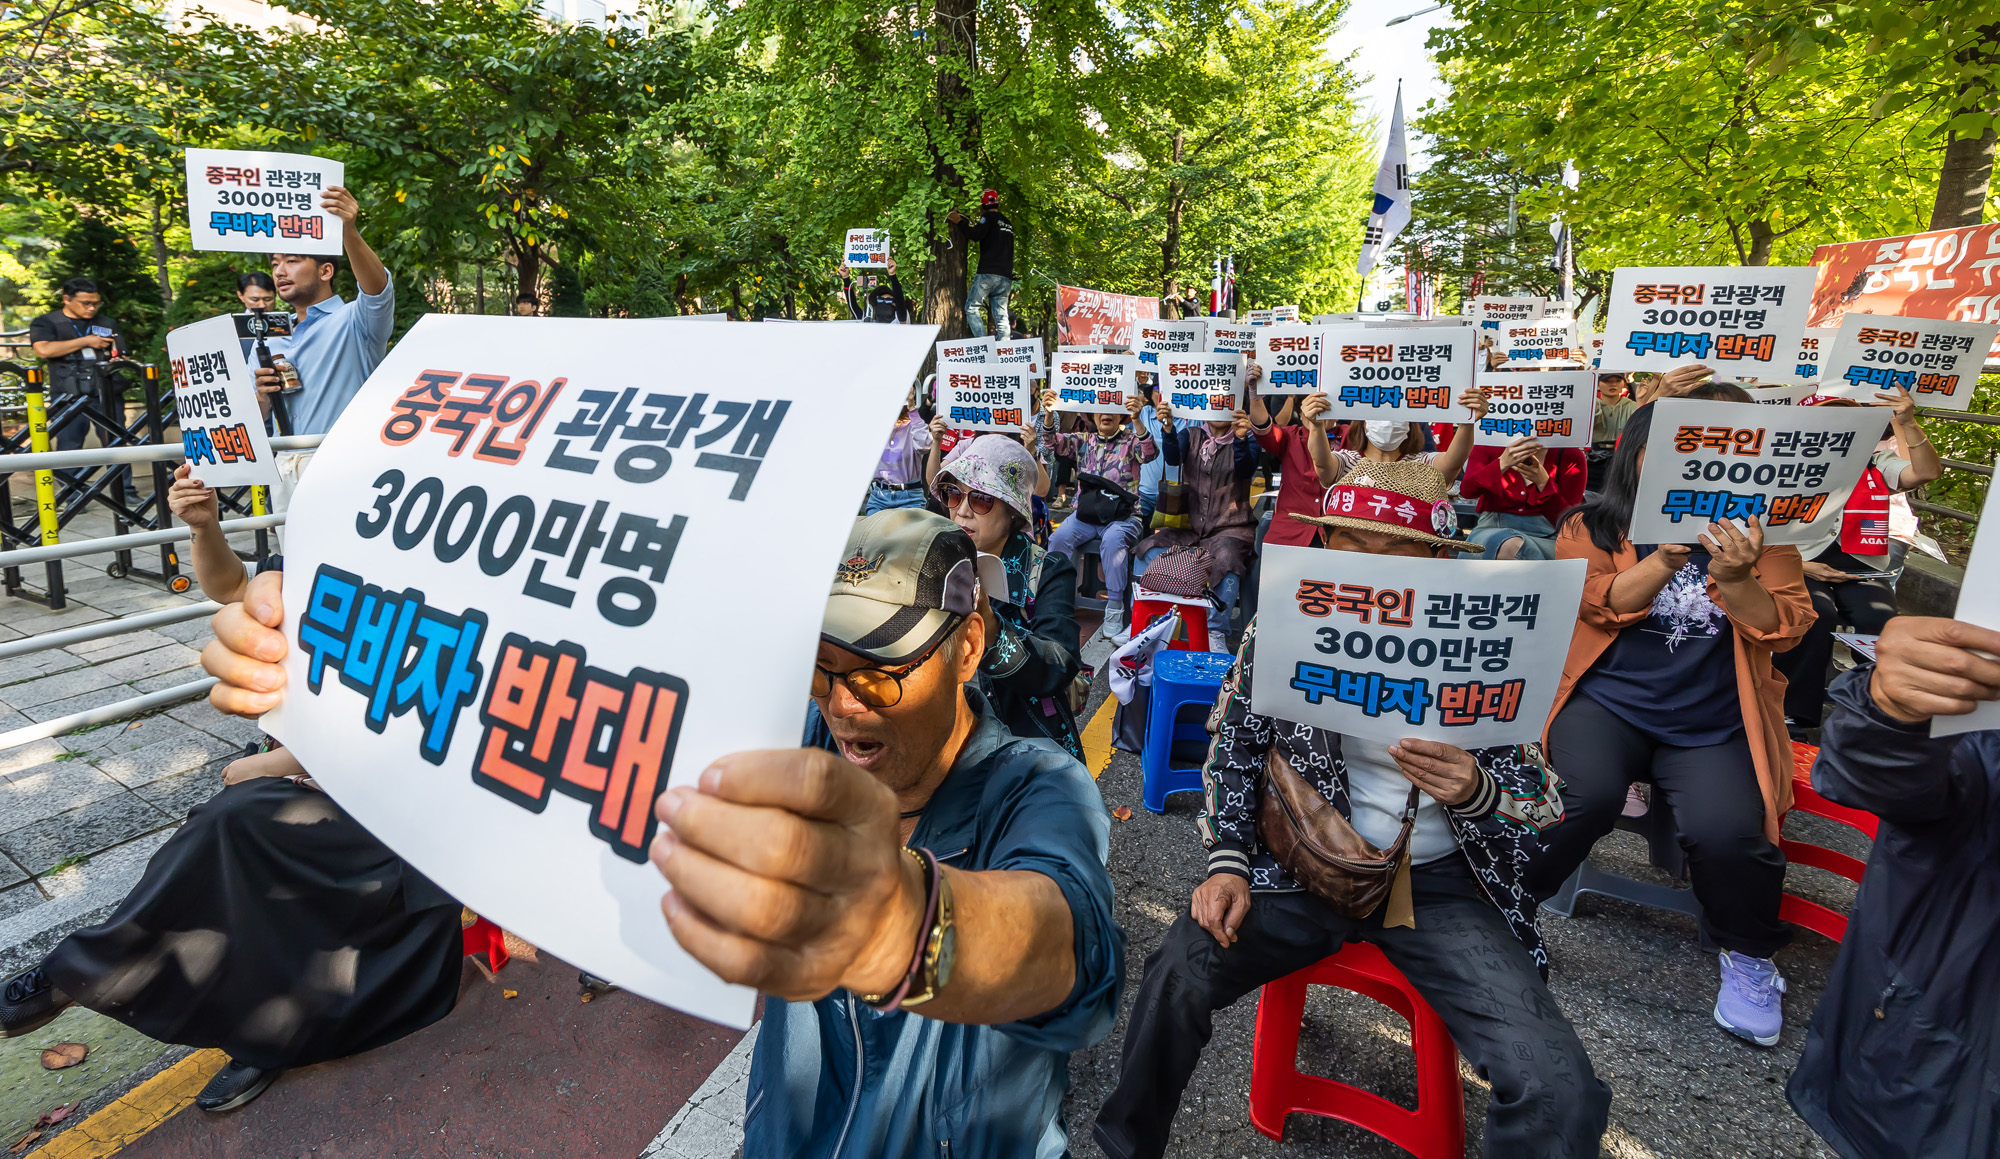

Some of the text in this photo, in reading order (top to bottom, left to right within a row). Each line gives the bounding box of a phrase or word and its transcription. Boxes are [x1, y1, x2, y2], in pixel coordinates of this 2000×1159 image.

[206, 166, 321, 190] 중국인 관광객
[217, 190, 312, 210] 3000만명
[210, 211, 323, 240] 무비자 반대
[848, 253, 886, 263] 무비자 반대
[1862, 230, 1977, 293] 중국인
[1633, 283, 1786, 306] 중국인 관광객
[1068, 291, 1101, 318] 중국인
[1097, 296, 1123, 322] 무비자
[1483, 303, 1507, 311] 중국인
[1508, 304, 1533, 312] 관광객
[1486, 312, 1528, 320] 3000만명
[1642, 309, 1767, 330] 3000만명
[1481, 320, 1500, 330] 무비
[1509, 328, 1567, 337] 중국인 관광객
[1142, 328, 1195, 342] 중국인 관광객
[1214, 330, 1237, 338] 중국인
[1513, 337, 1563, 346] 3000만명
[1857, 327, 1974, 354] 중국인 관광객
[943, 344, 988, 357] 중국인 관광객
[1014, 346, 1035, 355] 관광객
[1145, 341, 1189, 352] 3000만명
[1218, 340, 1256, 349] 3000만명
[1268, 336, 1310, 352] 중국인
[1340, 344, 1453, 361] 중국인 관광객
[1626, 331, 1713, 359] 무비자
[1716, 333, 1776, 362] 반대
[1000, 355, 1032, 363] 3000만명
[1138, 351, 1159, 365] 무비
[1276, 354, 1319, 366] 3000
[1508, 347, 1569, 360] 무비자 반대
[1862, 348, 1958, 371] 3000만명
[188, 350, 231, 384] 관광객
[1060, 363, 1124, 375] 중국인 관광객
[1168, 363, 1237, 377] 중국인 관광객
[1349, 366, 1441, 381] 3000만명
[948, 374, 1020, 389] 중국인 관광객
[1065, 376, 1117, 389] 3000만명
[1174, 378, 1231, 391] 3000만명
[1843, 364, 1917, 392] 무비자
[1916, 371, 1960, 396] 반대
[954, 391, 1014, 405] 3000만명
[1060, 389, 1123, 406] 무비자 반대
[1339, 385, 1450, 410] 무비자 반대
[1479, 384, 1574, 400] 중국인 관광객
[1171, 393, 1236, 410] 무비자 반대
[1488, 401, 1565, 415] 3000만명
[950, 406, 1021, 426] 무비자 반대
[379, 369, 792, 501] 중국인 관광객
[1479, 418, 1572, 437] 무비자 반대
[210, 422, 256, 464] 반대
[1673, 425, 1856, 458] 중국인 관광객
[1682, 460, 1831, 489] 3000만명
[1367, 494, 1418, 524] 구속
[1662, 488, 1831, 527] 무비자 반대
[355, 466, 688, 628] 3000만명
[1295, 577, 1540, 631] 중국인 관광객
[1313, 627, 1514, 673] 3000만명
[1289, 660, 1527, 728] 무비자 반대
[298, 562, 690, 865] 무비자 반대
